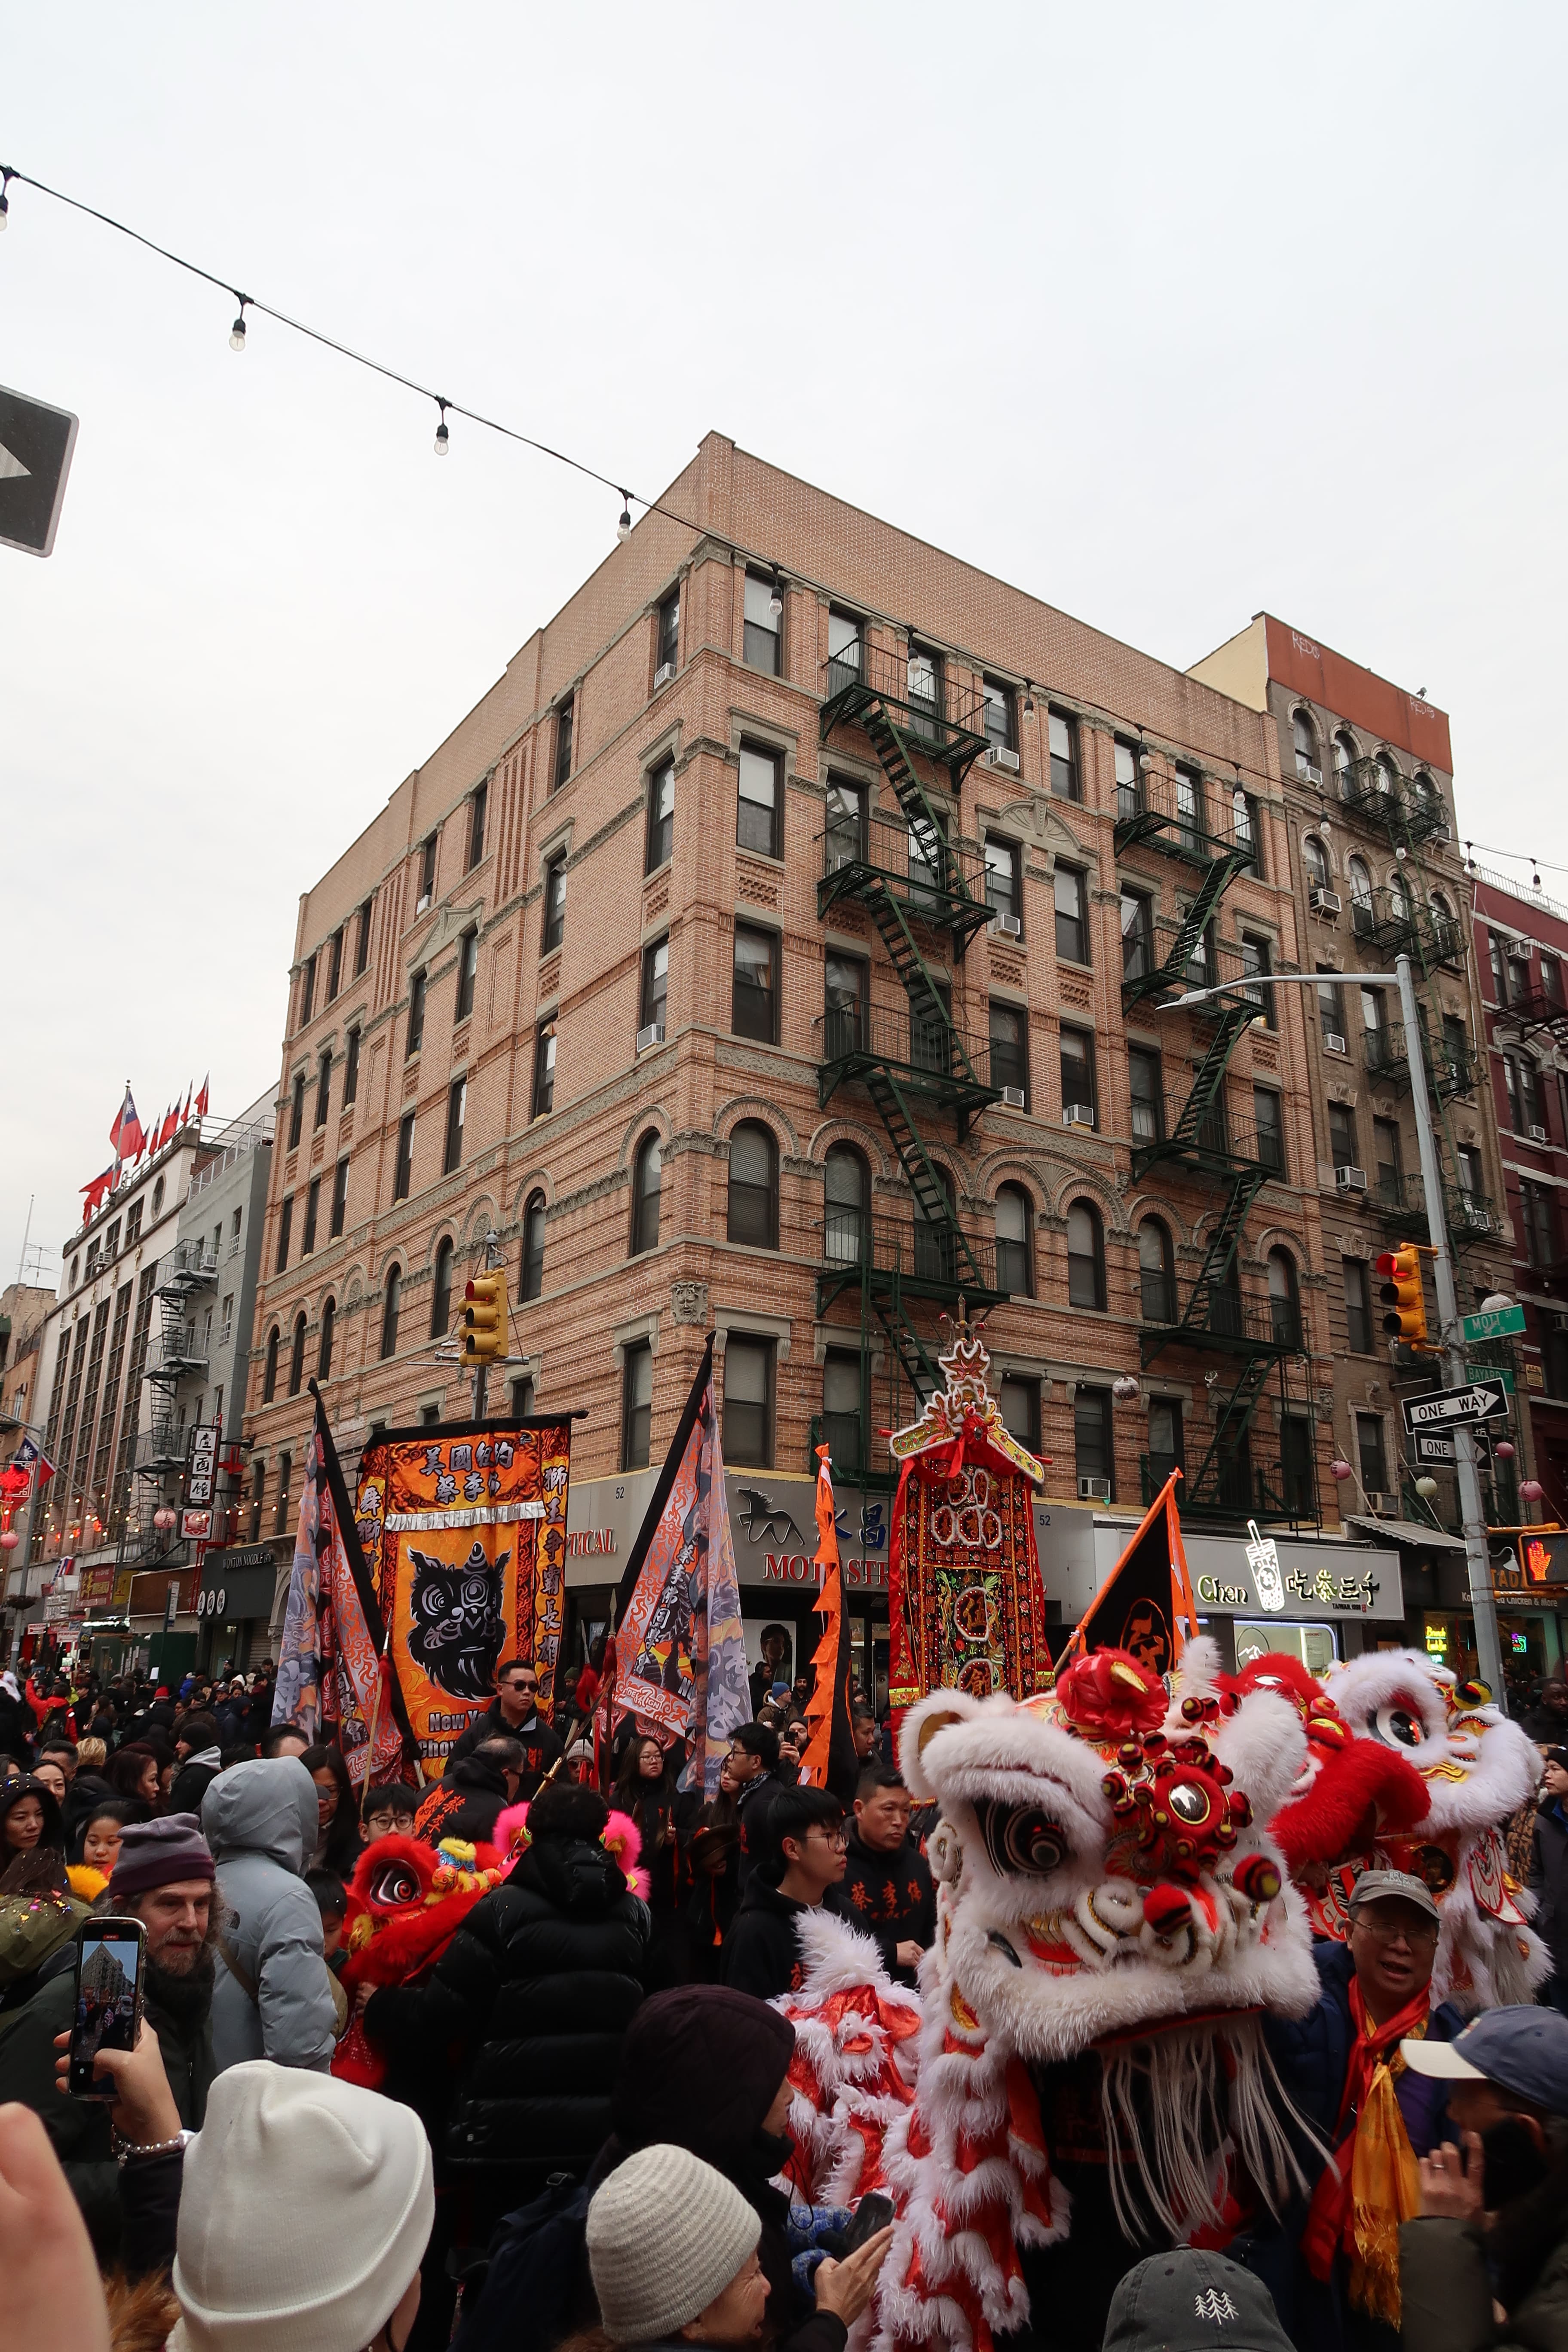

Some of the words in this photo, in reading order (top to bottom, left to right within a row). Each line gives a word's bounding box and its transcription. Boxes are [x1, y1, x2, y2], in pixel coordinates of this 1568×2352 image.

[1472, 1313, 1500, 1331] MOTT
[1468, 1367, 1501, 1380] BAYARD
[1418, 1403, 1447, 1420] ONE
[1458, 1393, 1488, 1412] WAY
[1427, 1441, 1449, 1456] ONE
[419, 1440, 514, 1477] 美國紐約
[616, 1486, 625, 1499] 52
[1039, 1515, 1051, 1526] 52
[846, 1558, 889, 1586] STR
[1286, 1568, 1380, 1607] 吃茶三千
[1541, 1598, 1558, 1607] More
[429, 1712, 465, 1732] New
[1389, 1871, 1408, 1880] ERIC
